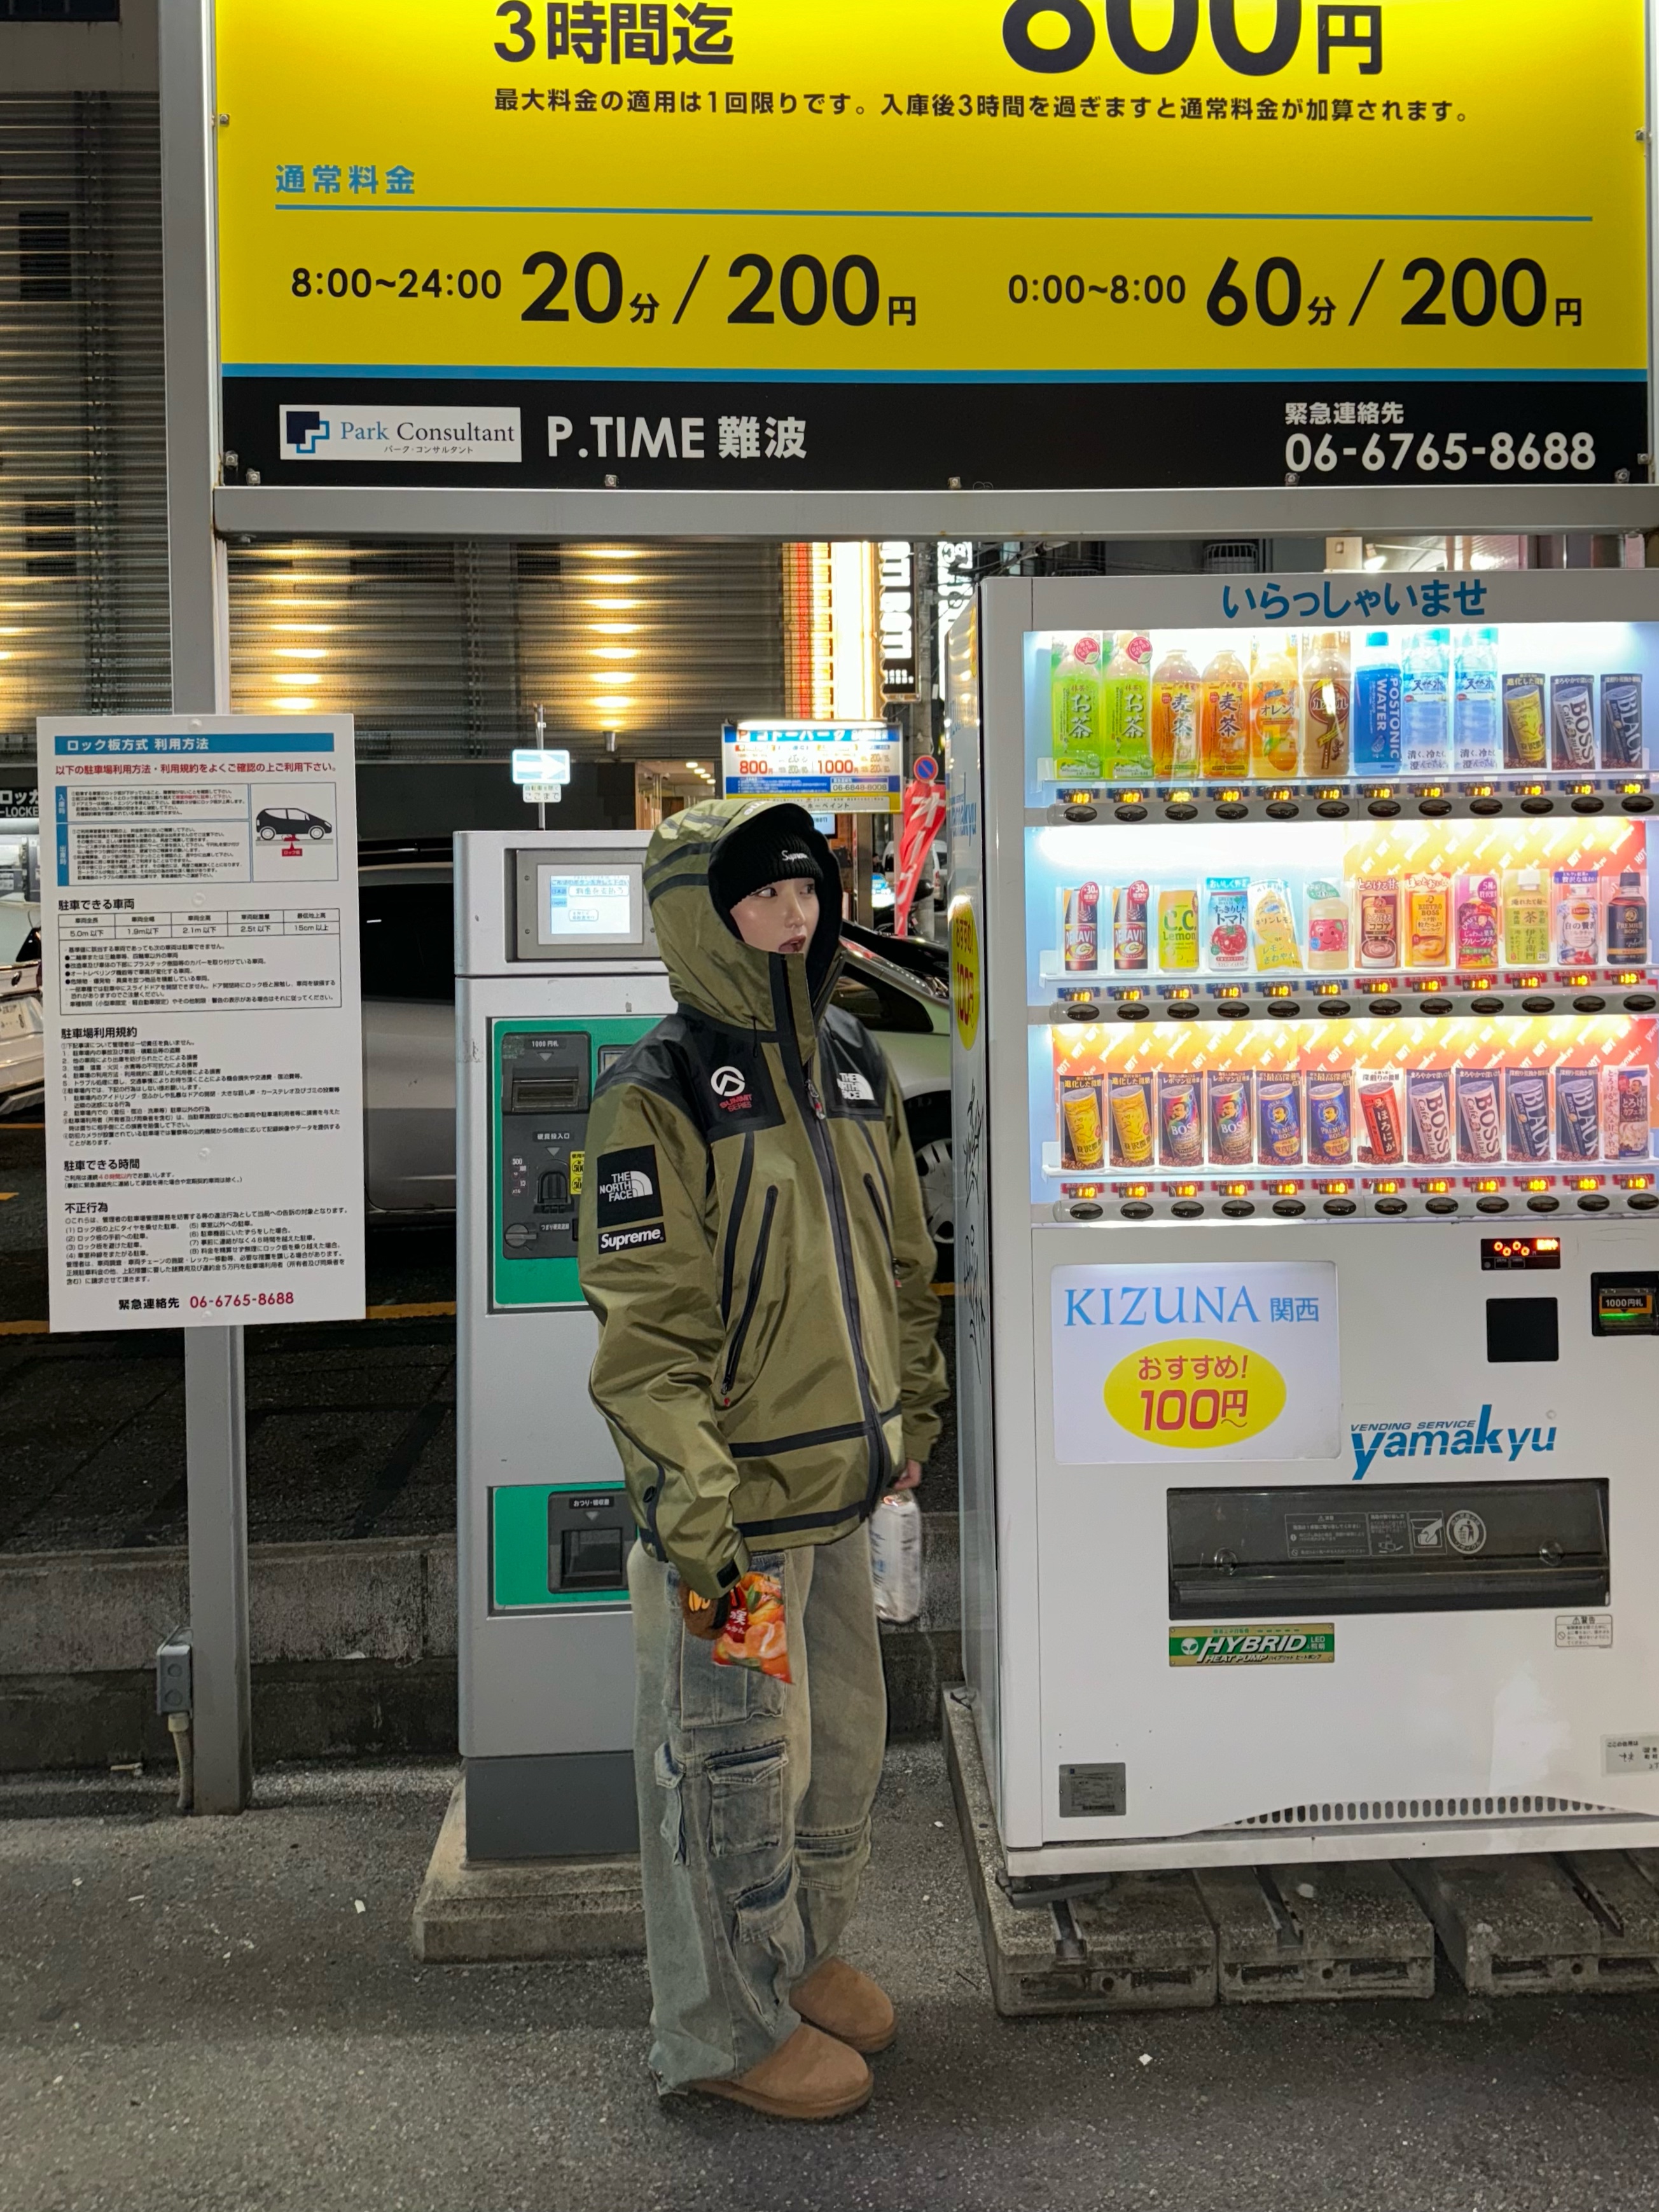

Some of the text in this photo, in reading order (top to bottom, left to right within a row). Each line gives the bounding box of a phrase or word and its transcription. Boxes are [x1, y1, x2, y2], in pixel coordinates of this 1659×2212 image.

[275, 164, 416, 195] 通常料金
[1285, 401, 1405, 425] 緊急連絡先
[341, 420, 516, 444] Park Consultant
[547, 415, 808, 461] P.TIME 難波
[1285, 432, 1596, 472] 06-6765-8688
[1223, 579, 1487, 619] いらっしゃいませ
[1067, 693, 1093, 739] お茶
[1122, 693, 1146, 739] お茶
[1218, 691, 1241, 738] 麦茶
[1376, 678, 1387, 731] WATER
[1389, 677, 1399, 759] POSTONIC
[1570, 697, 1595, 764] BOSS
[1616, 689, 1641, 763] BLACK
[67, 738, 209, 752] ロック板方式 利用方法
[524, 792, 559, 801] ここまで
[58, 898, 135, 911] 駐車できる車両
[1524, 911, 1537, 923] 茶
[1216, 912, 1245, 925] トマト
[1368, 922, 1391, 930] ココア
[1162, 930, 1197, 941] Lemon
[60, 1027, 137, 1039] 駐車場利用規約
[1377, 1110, 1396, 1152] ほろにが
[1425, 1093, 1450, 1156] BOSS
[1474, 1092, 1501, 1157] BOSS
[1522, 1086, 1549, 1156] BLACK
[1571, 1086, 1599, 1156] BLACK
[64, 1158, 141, 1172] 駐車できる時間
[611, 1172, 631, 1182] THE
[599, 1180, 632, 1194] NORTH
[608, 1190, 634, 1203] FACE
[64, 1201, 109, 1214] 不正行為
[600, 1229, 662, 1251] Supreme
[118, 1292, 295, 1311] 緊急連絡先 06-6765-8688
[1064, 1285, 1321, 1327] KIZUNA 関西
[1138, 1355, 1248, 1381] おすすめ!
[1350, 1420, 1476, 1432] VENDING SERVICE
[1350, 1404, 1557, 1481] yamakyu
[1197, 1635, 1307, 1663] HYBRID
[1203, 1654, 1268, 1663] HEAT PUMP
